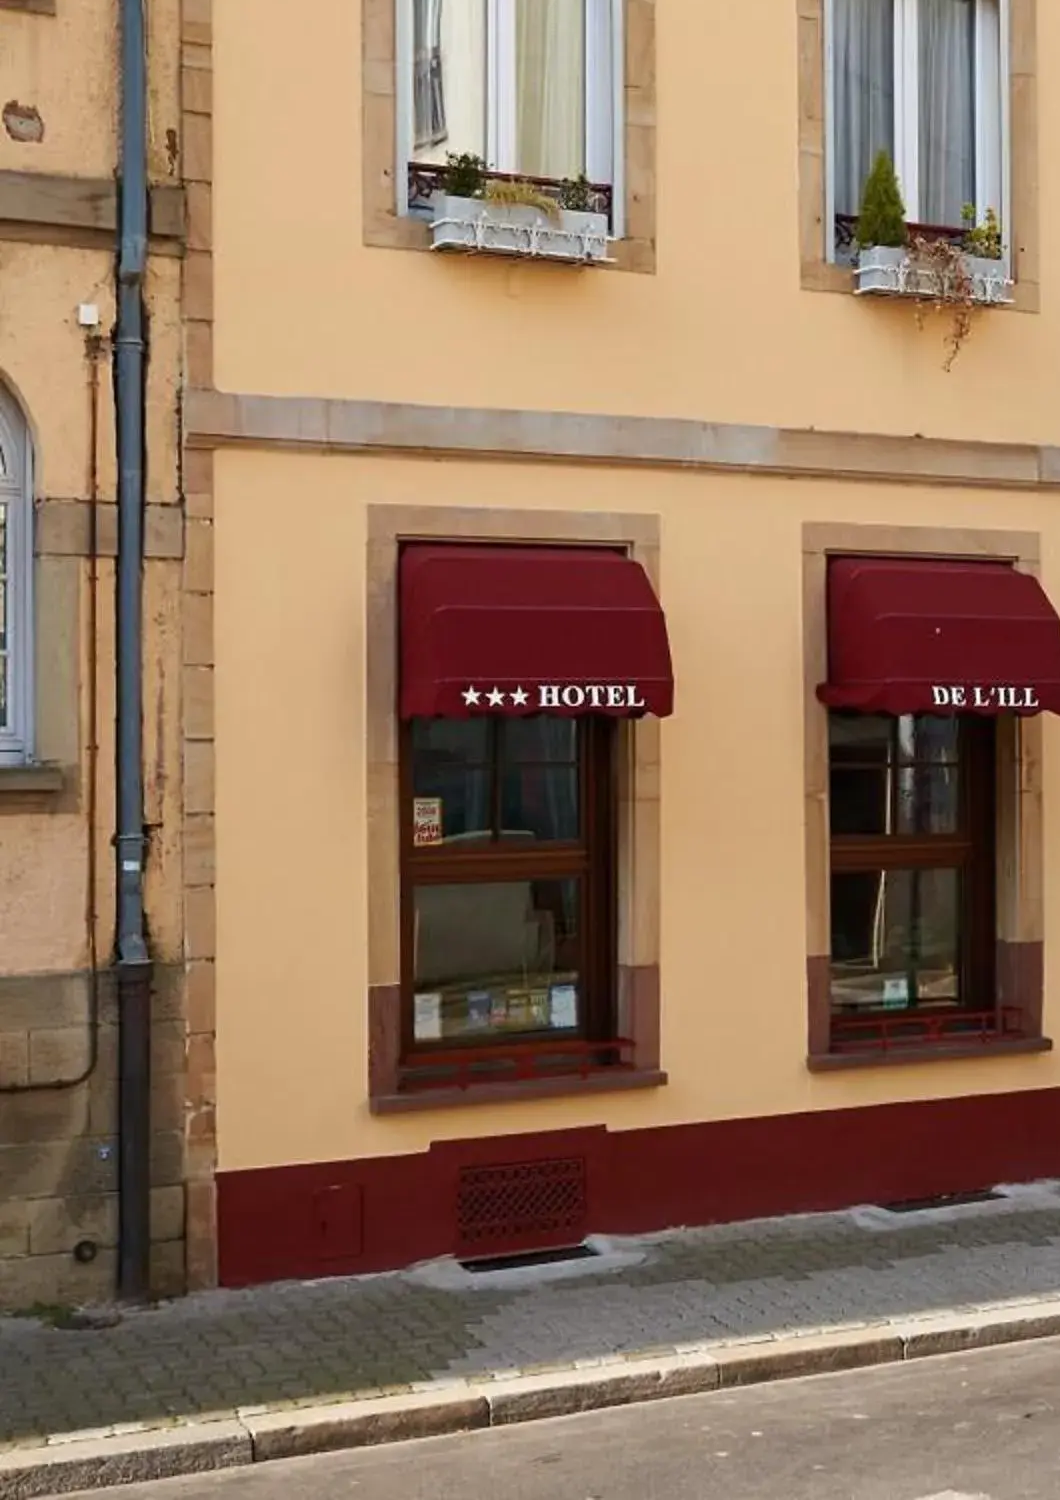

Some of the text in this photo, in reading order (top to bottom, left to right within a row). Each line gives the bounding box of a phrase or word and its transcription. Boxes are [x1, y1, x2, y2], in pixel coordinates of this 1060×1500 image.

[538, 685, 645, 707] HOTEL
[932, 686, 1039, 706] DE L'ILL
